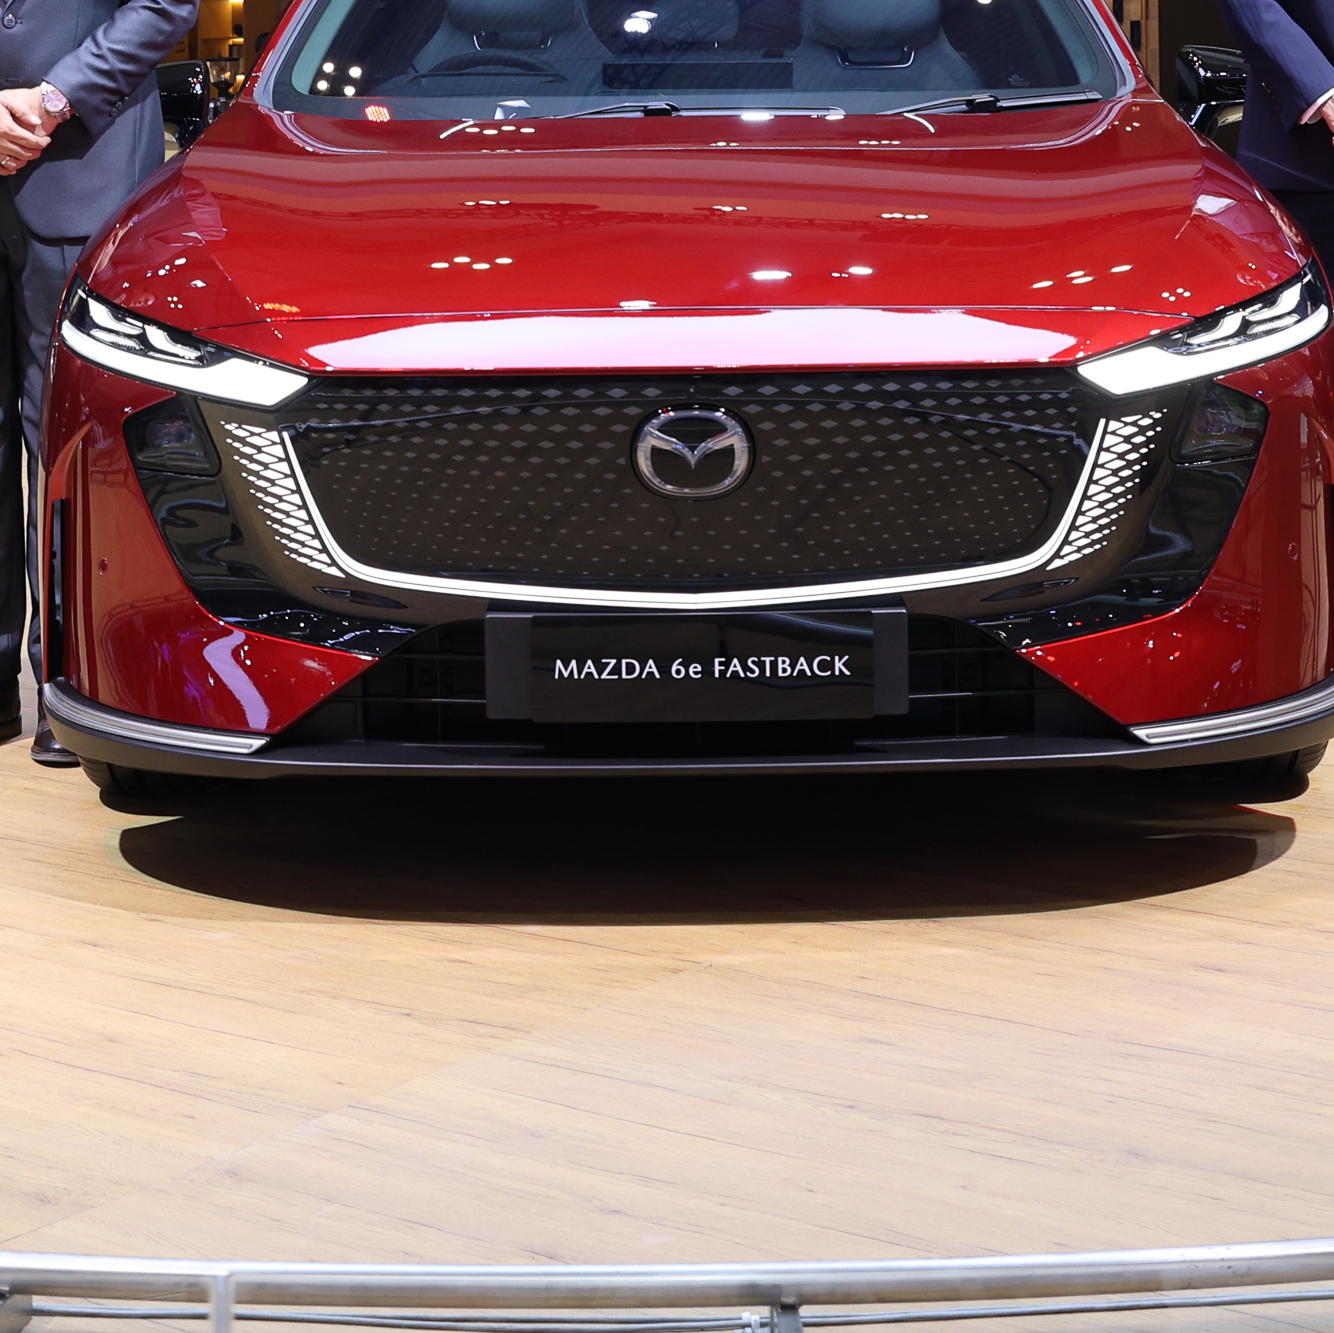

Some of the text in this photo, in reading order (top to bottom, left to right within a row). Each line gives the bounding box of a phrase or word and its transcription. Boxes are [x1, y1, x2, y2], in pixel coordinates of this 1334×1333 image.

[554, 655, 852, 680] MAZDA 6e FASTBACK
